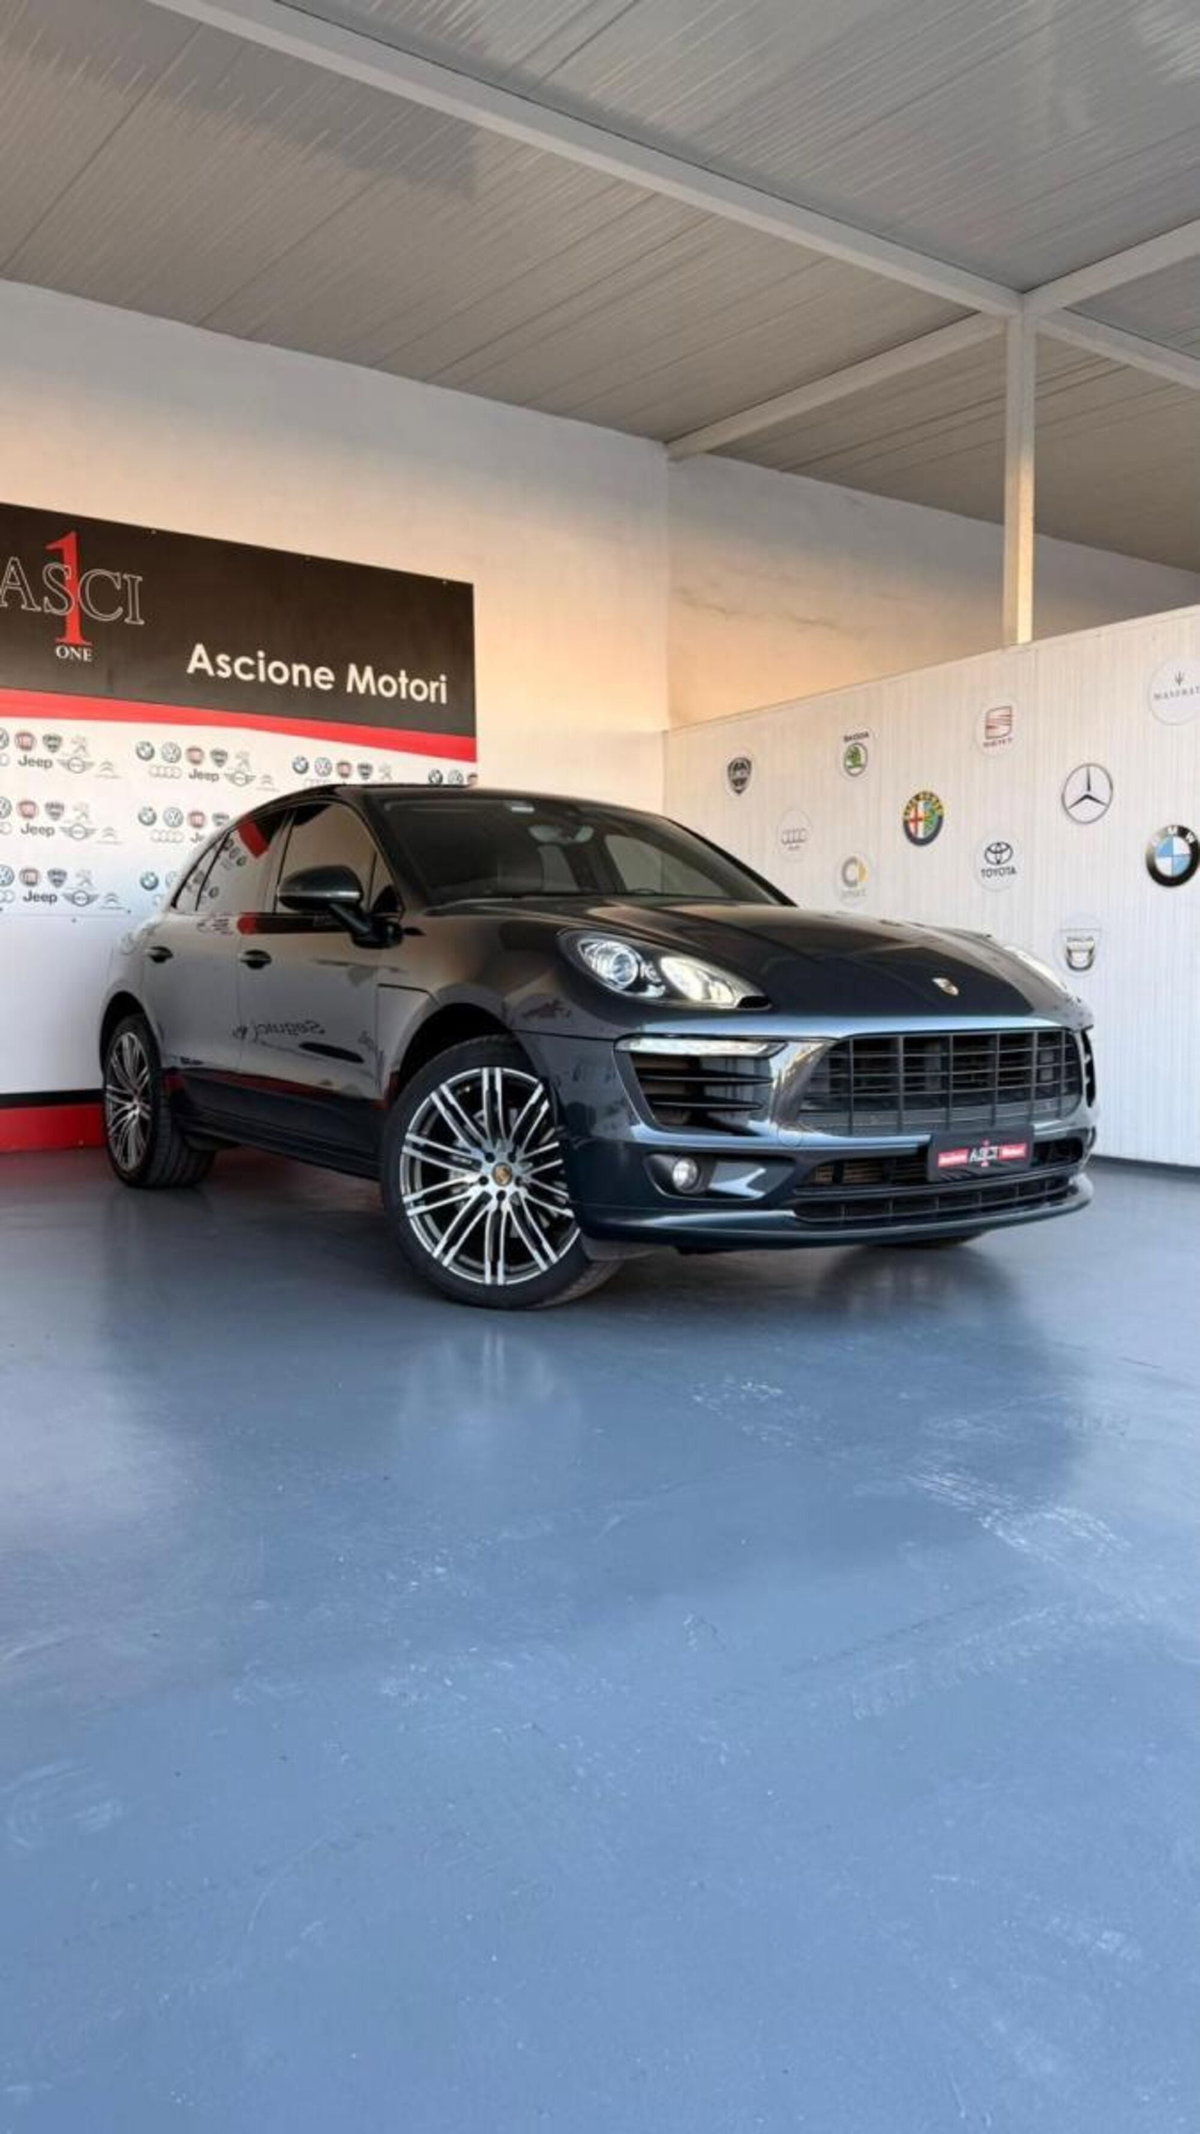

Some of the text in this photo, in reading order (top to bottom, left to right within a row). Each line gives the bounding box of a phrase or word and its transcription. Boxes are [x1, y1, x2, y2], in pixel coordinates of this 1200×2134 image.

[0, 556, 145, 625] ASCI
[56, 645, 93, 662] ONE
[186, 643, 448, 704] Ascione Motori
[18, 754, 53, 770] Jeep
[188, 769, 220, 782] Jeep
[20, 822, 55, 838] Jeep
[981, 866, 1016, 878] TOYOTA
[23, 890, 58, 905] Jeep
